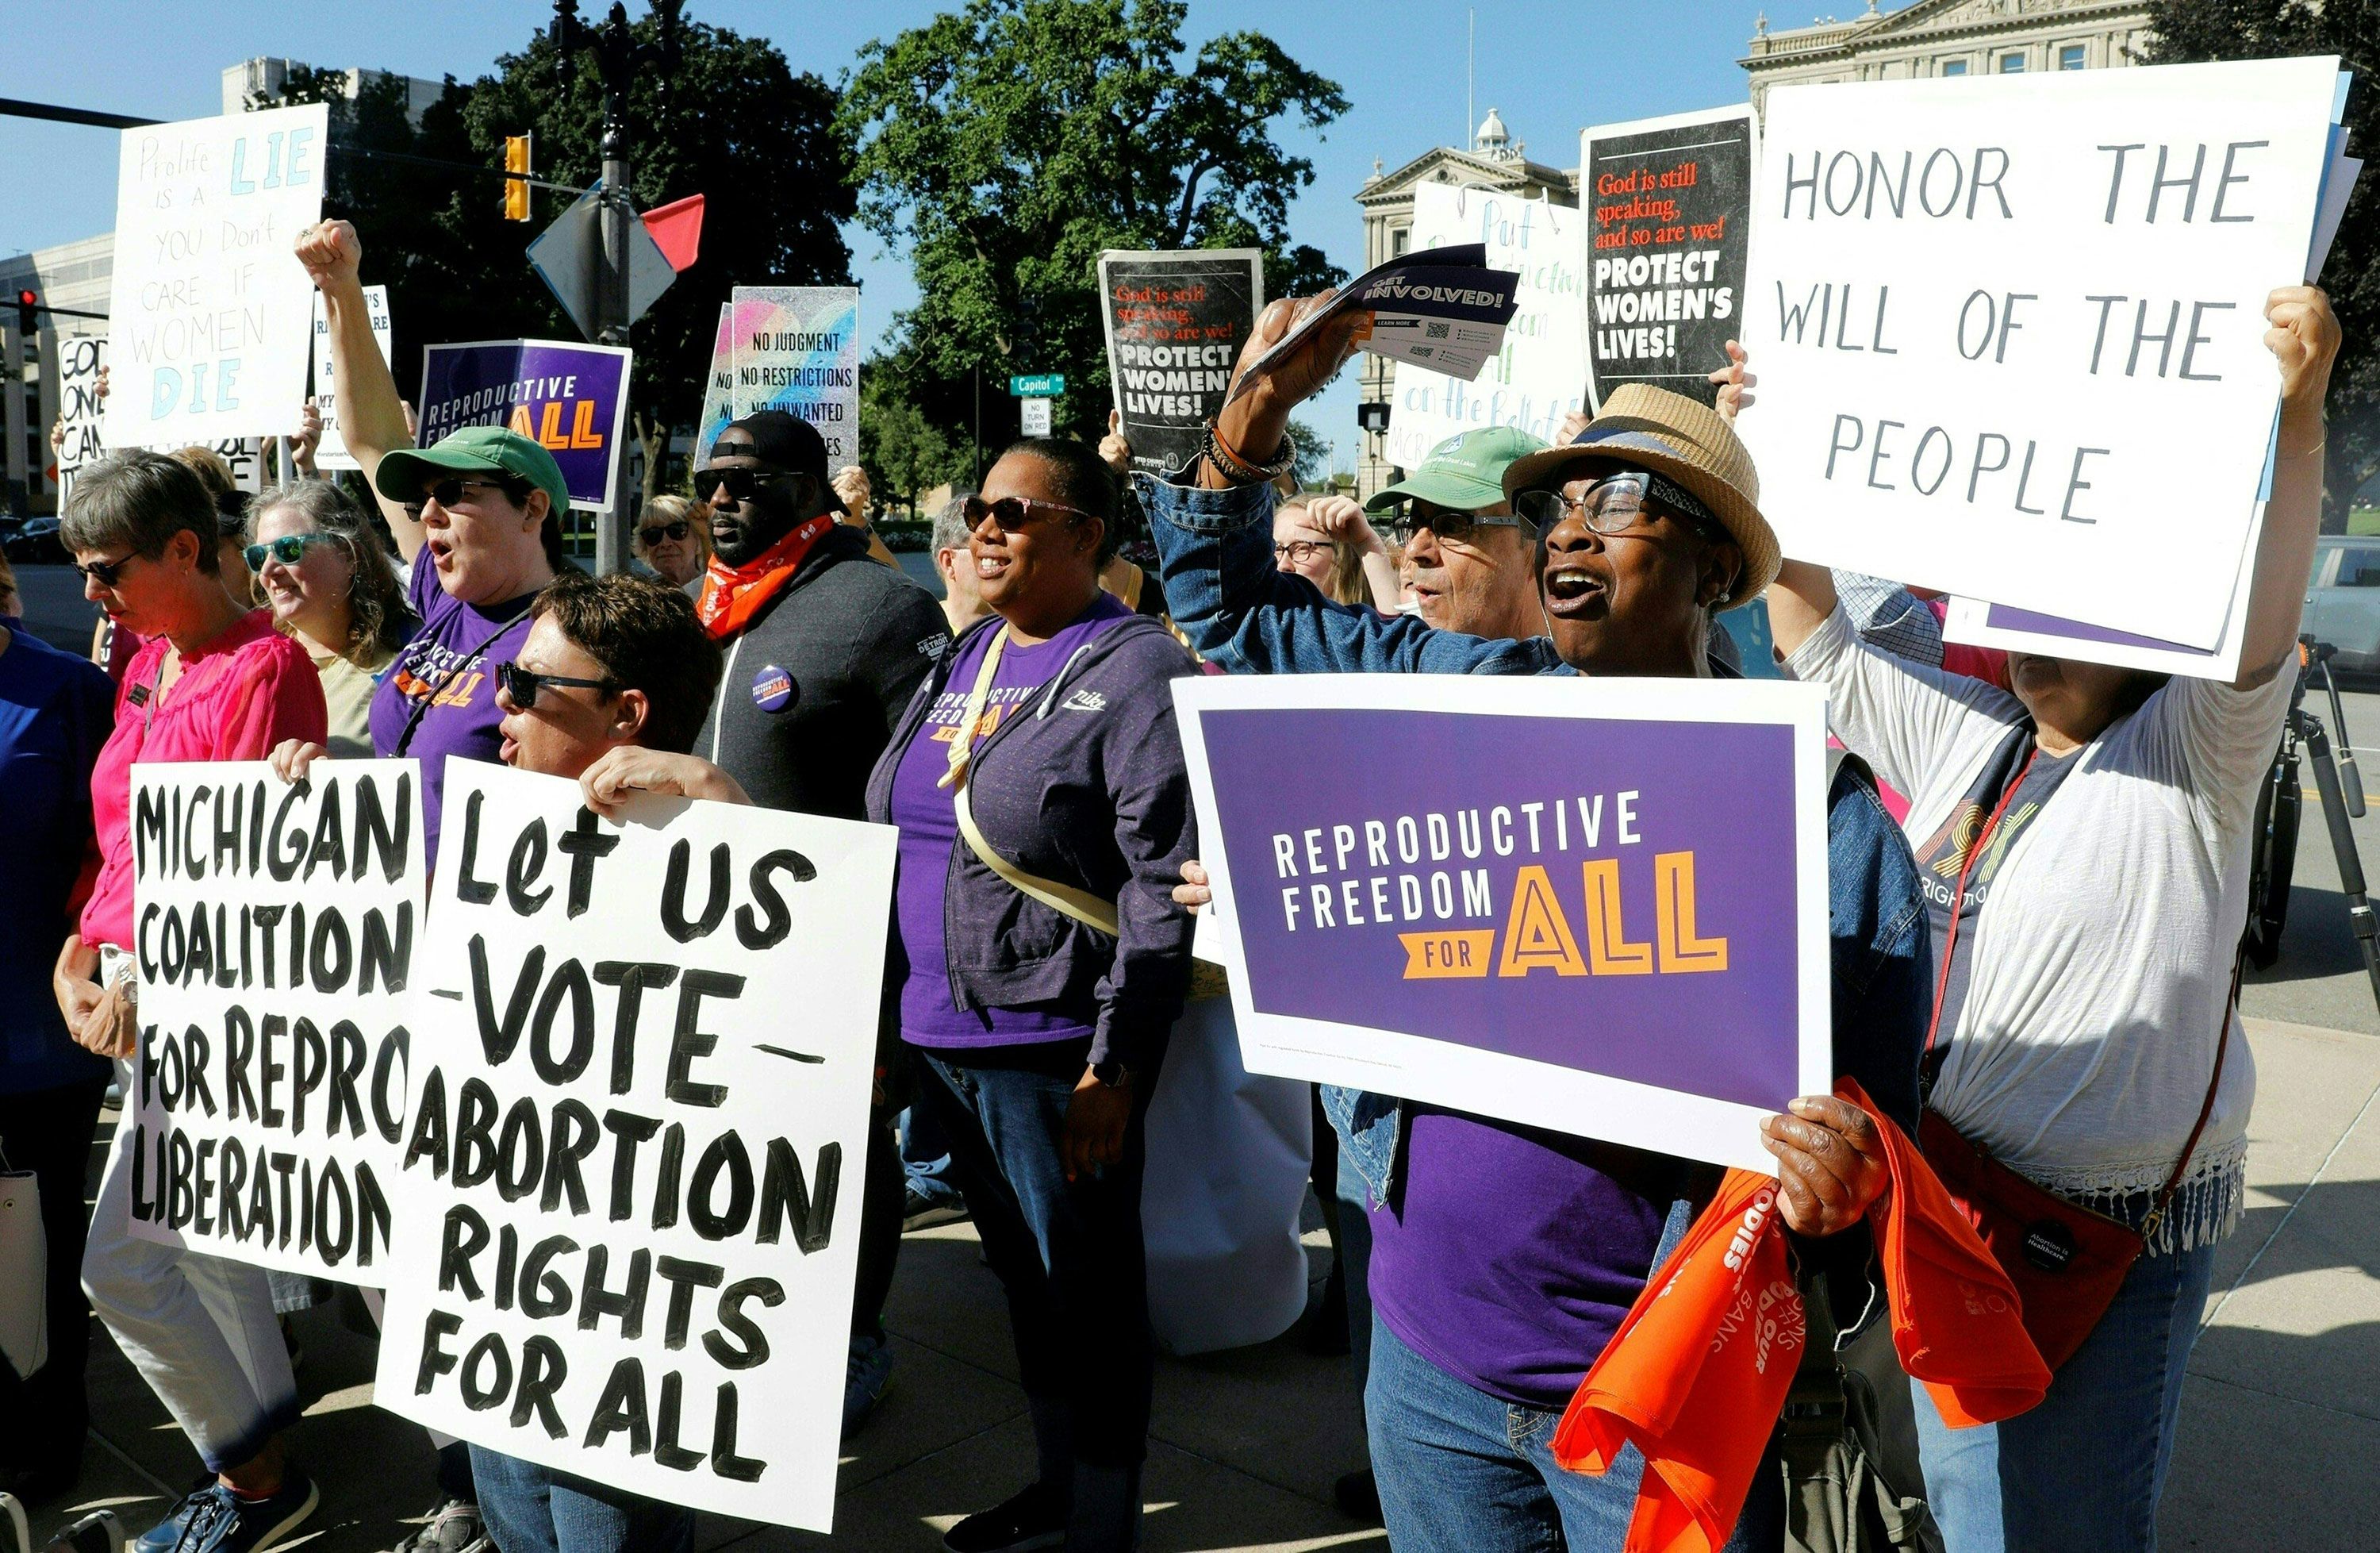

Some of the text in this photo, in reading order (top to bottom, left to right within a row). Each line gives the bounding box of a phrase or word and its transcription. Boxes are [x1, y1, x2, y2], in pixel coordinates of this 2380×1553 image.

[140, 126, 313, 196] Prolife LIE
[1598, 162, 1698, 195] God is still
[1783, 140, 2270, 225] HONOR THE
[156, 186, 205, 209] IS A
[1596, 195, 1681, 225] speaking,
[156, 213, 274, 264] YOU Don't
[1484, 199, 1537, 250] Put
[1595, 216, 1725, 250] and so are we!
[142, 263, 255, 312] CARE IF
[1372, 276, 1406, 287] GET
[1595, 250, 1720, 289] PROTECT
[1115, 285, 1206, 303] God is still
[1363, 285, 1504, 308] INVOLVED!
[1595, 287, 1733, 325] WOMEN'S
[131, 303, 264, 365] WOMEN
[753, 333, 840, 352] NO JUDGMENT
[1153, 329, 1170, 340] so
[1174, 328, 1200, 340] are
[1203, 322, 1235, 340] we!
[1597, 328, 1676, 359] LIVES!
[1776, 280, 2236, 382] WILL OF THE
[741, 367, 852, 387] NO RESTRICTIONS
[1121, 344, 1232, 367] PROTECT
[151, 358, 240, 420] DIE
[428, 375, 578, 425] REPRODUCTIVE
[716, 372, 732, 390] NO
[1019, 378, 1050, 394] Capitol
[1123, 370, 1231, 393] WOMEN'
[1405, 386, 1437, 414] on
[1442, 377, 1483, 422] the
[508, 399, 604, 450] ALL
[1126, 395, 1203, 417] LIVES!
[1825, 413, 2110, 525] PEOPLE
[918, 636, 948, 654] DETROIT
[138, 771, 411, 886] MICHIGAN
[1273, 790, 1641, 878] REPRODUCTIVE
[456, 790, 818, 950] Let US
[1281, 868, 1491, 932] FREEDOM
[1423, 850, 1729, 978] FOR ALL
[138, 898, 413, 997] COALITION
[141, 1004, 411, 1144] FOR REPRO
[404, 1064, 843, 1257] ABORTION
[132, 1122, 391, 1267] LIBERATION
[2028, 1238, 2066, 1262] Healthcare.
[2030, 1233, 2061, 1252] Abortion
[439, 1204, 786, 1371] RIGHTS
[414, 1307, 769, 1485] FOR ALL
